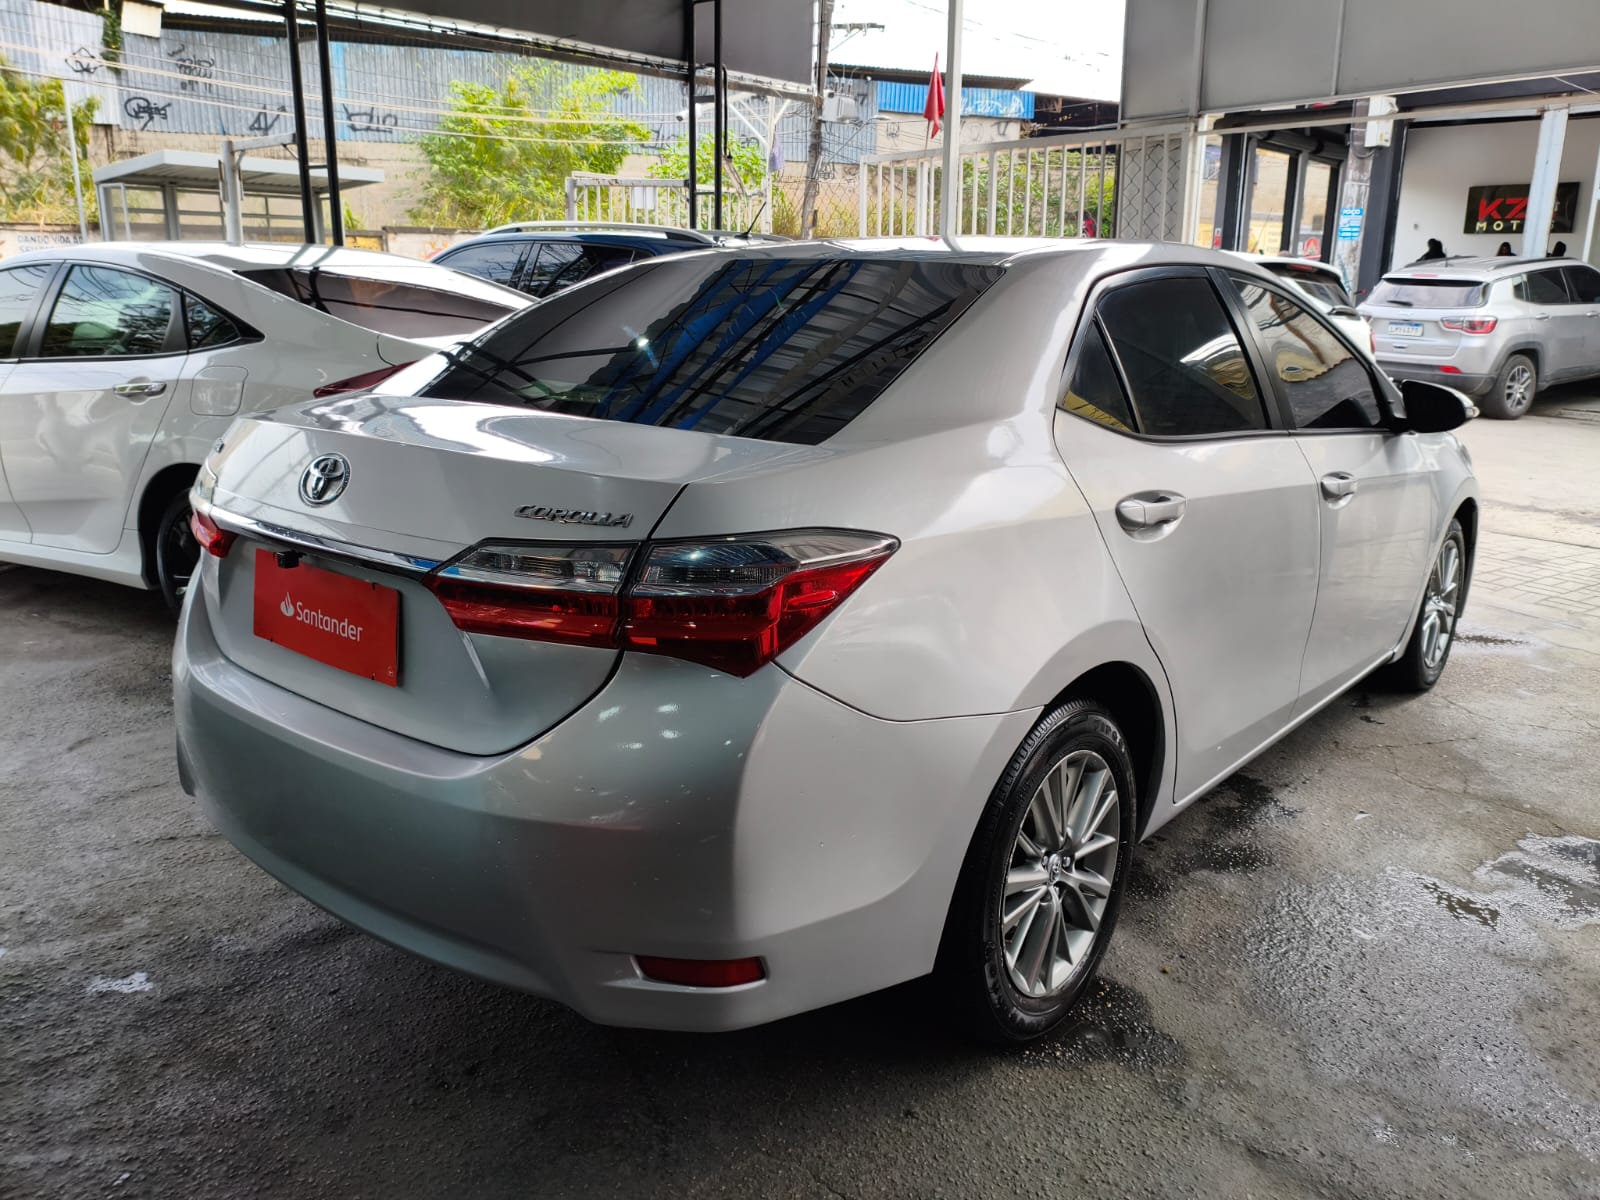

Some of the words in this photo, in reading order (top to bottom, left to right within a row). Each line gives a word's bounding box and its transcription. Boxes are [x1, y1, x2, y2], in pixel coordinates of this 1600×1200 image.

[17, 234, 50, 245] DANDO
[52, 234, 71, 245] VIDA
[514, 504, 634, 528] COROLLA
[296, 601, 364, 642] Santander
